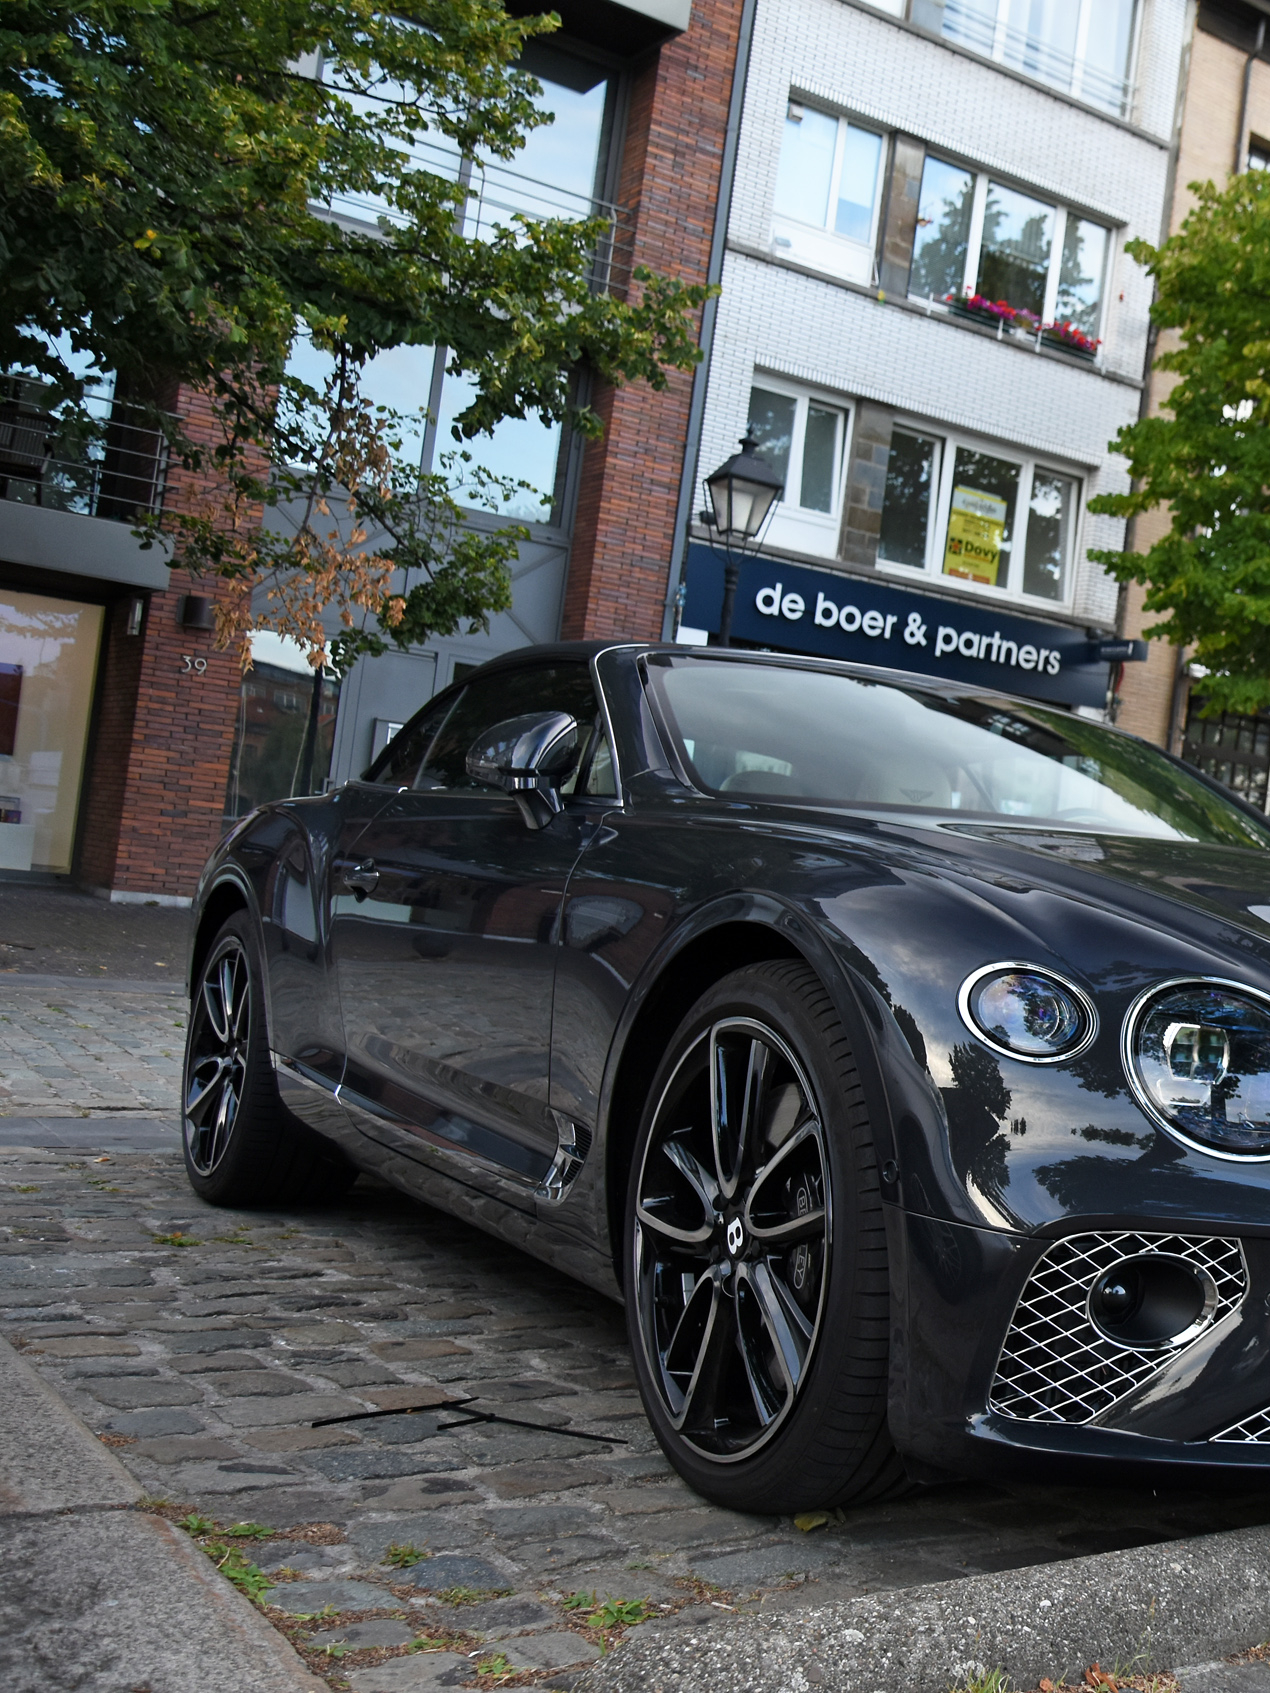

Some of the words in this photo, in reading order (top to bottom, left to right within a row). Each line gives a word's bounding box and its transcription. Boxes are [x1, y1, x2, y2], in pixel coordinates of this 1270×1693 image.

[965, 541, 998, 563] Dovy
[755, 583, 805, 620] de
[814, 592, 898, 639] boer
[903, 612, 928, 646] &
[934, 626, 1061, 675] partners
[181, 655, 207, 675] 39
